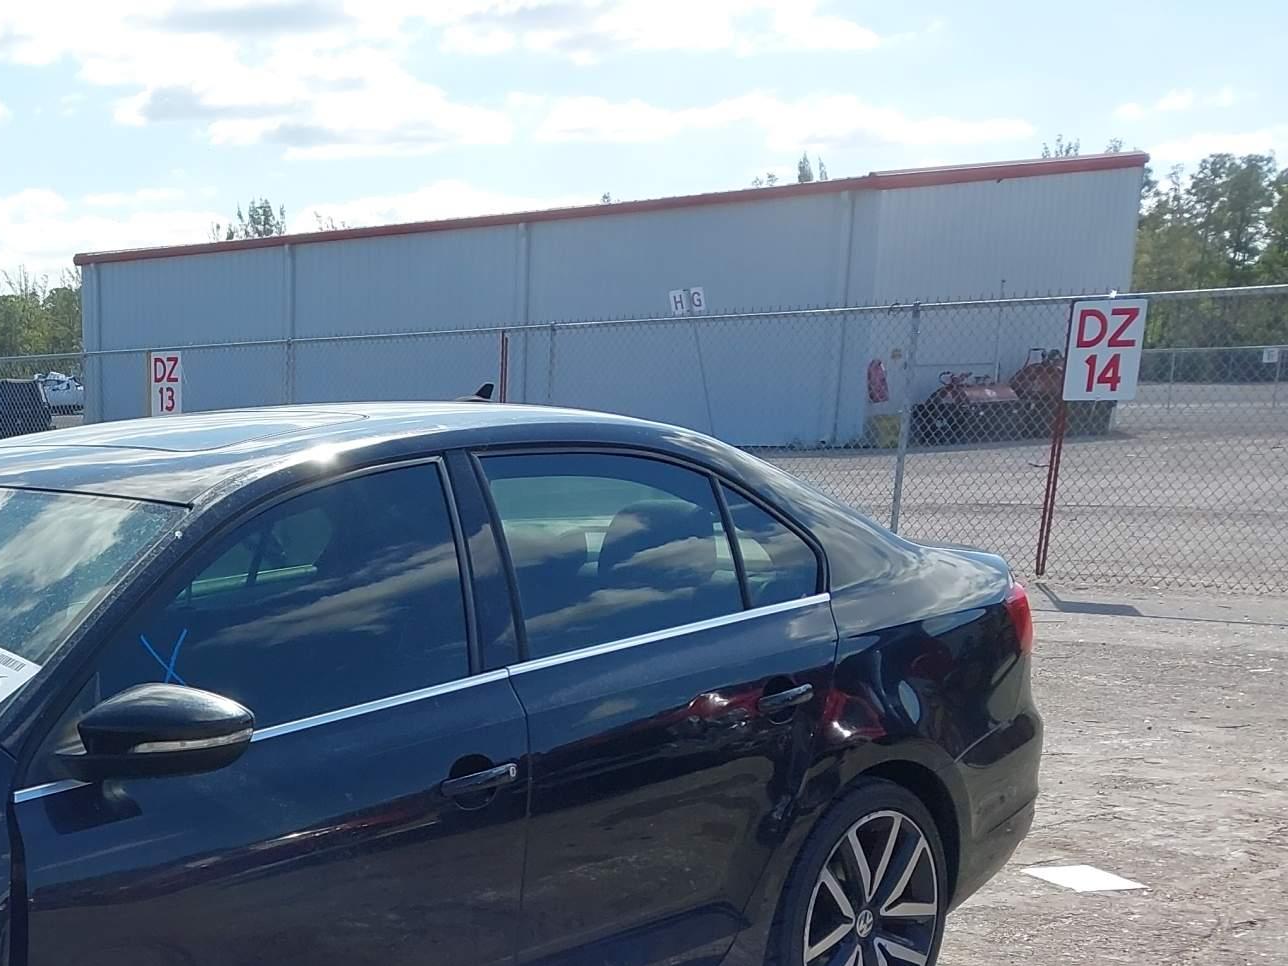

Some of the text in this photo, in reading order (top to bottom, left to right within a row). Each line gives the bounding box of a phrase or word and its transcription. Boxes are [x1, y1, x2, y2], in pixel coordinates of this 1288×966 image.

[673, 291, 702, 310] H G
[1076, 308, 1140, 348] DZ
[153, 357, 178, 383] DZ
[1085, 353, 1121, 392] 14
[158, 386, 175, 412] 13
